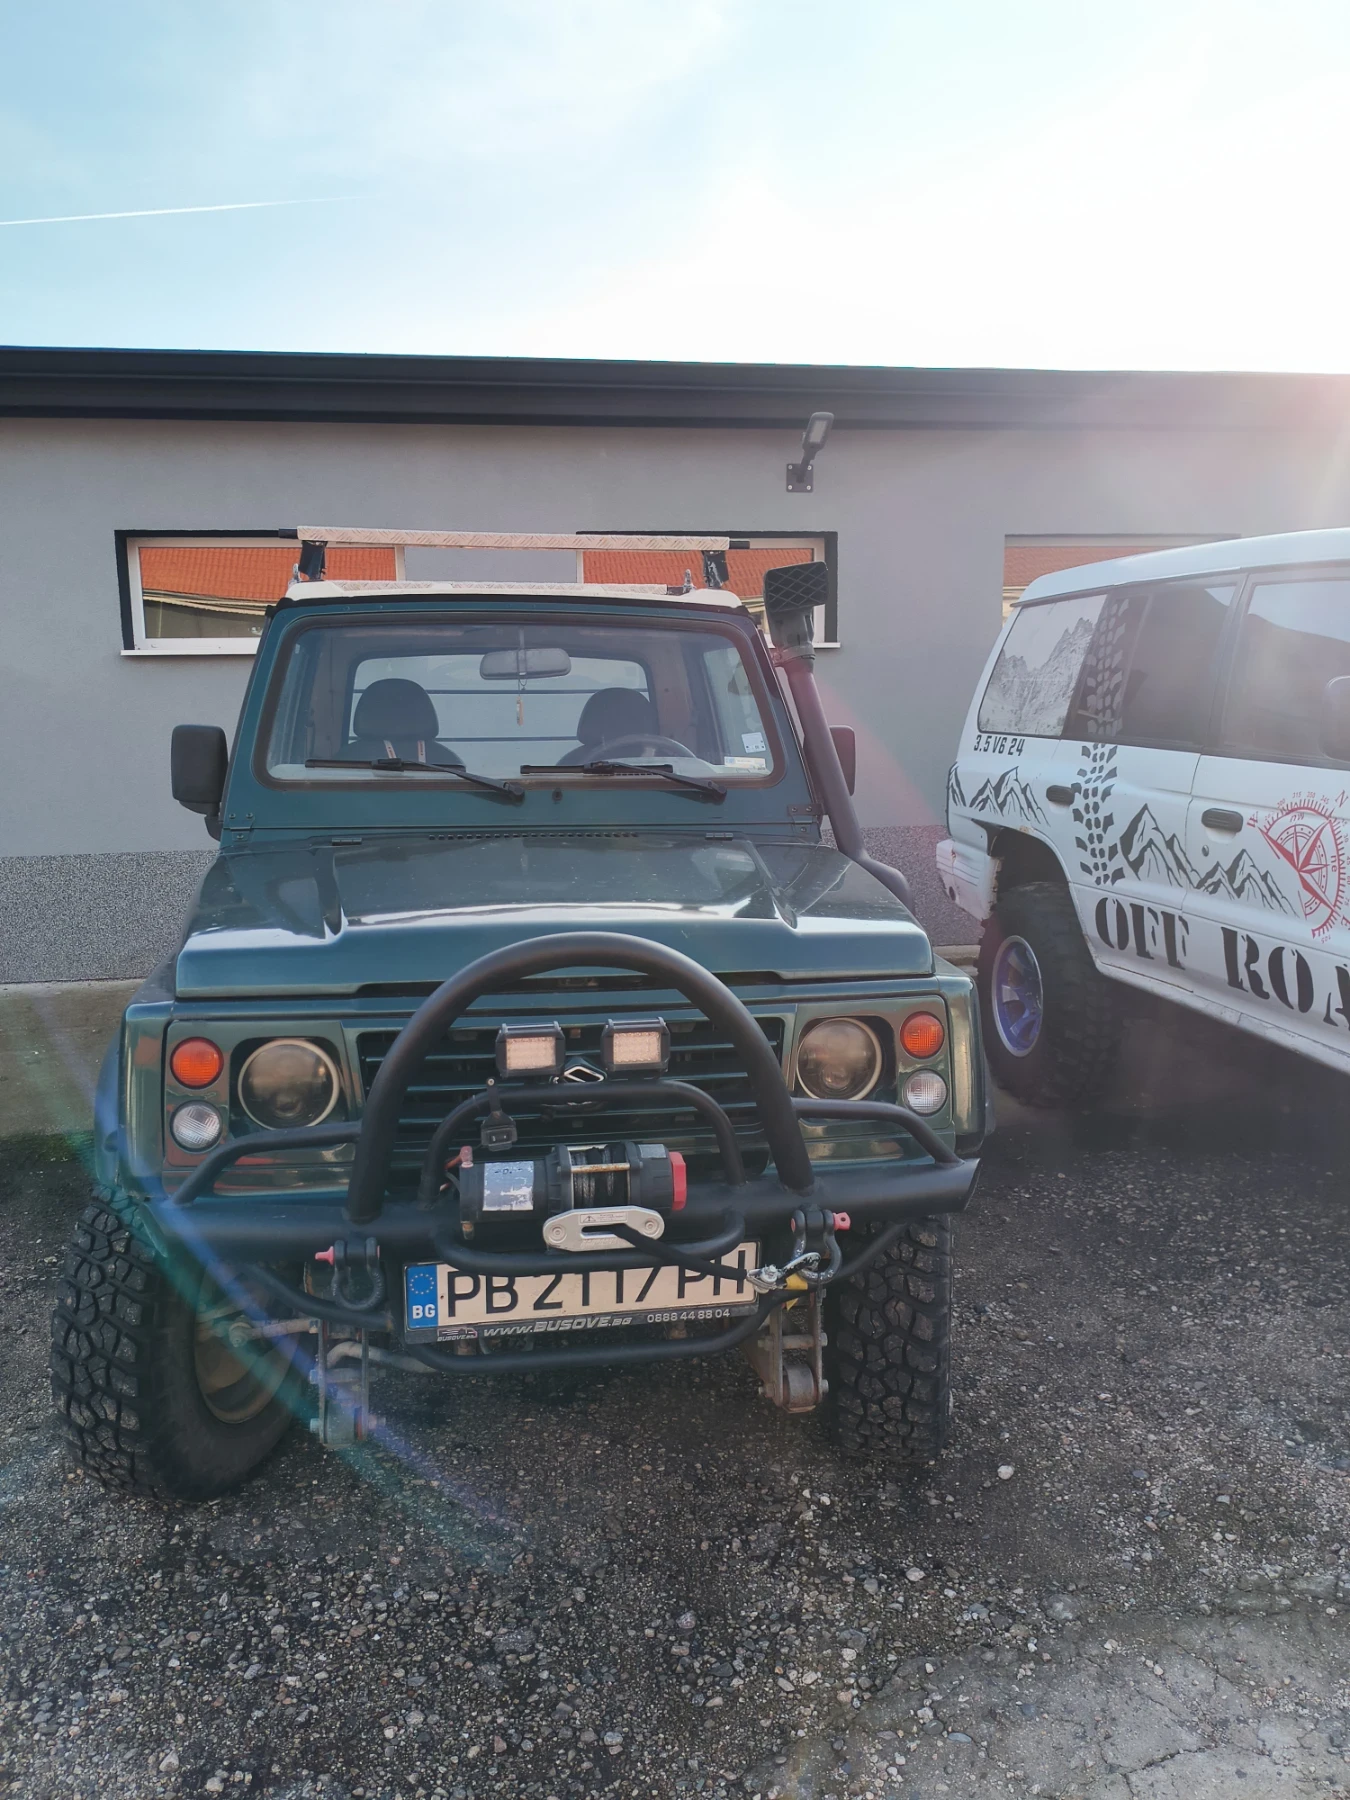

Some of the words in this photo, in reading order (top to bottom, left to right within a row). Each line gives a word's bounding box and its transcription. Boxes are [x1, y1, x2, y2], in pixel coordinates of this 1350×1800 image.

[974, 734, 992, 752] 3.5
[992, 736, 1007, 754] V6
[1008, 738, 1025, 756] 24
[1335, 789, 1349, 808] N
[1095, 897, 1190, 971] OFF
[447, 1271, 519, 1317] PB
[412, 1304, 435, 1319] BG
[647, 1312, 678, 1323] 0888
[680, 1311, 696, 1321] 44
[697, 1310, 713, 1319] 88
[715, 1309, 730, 1318] 04
